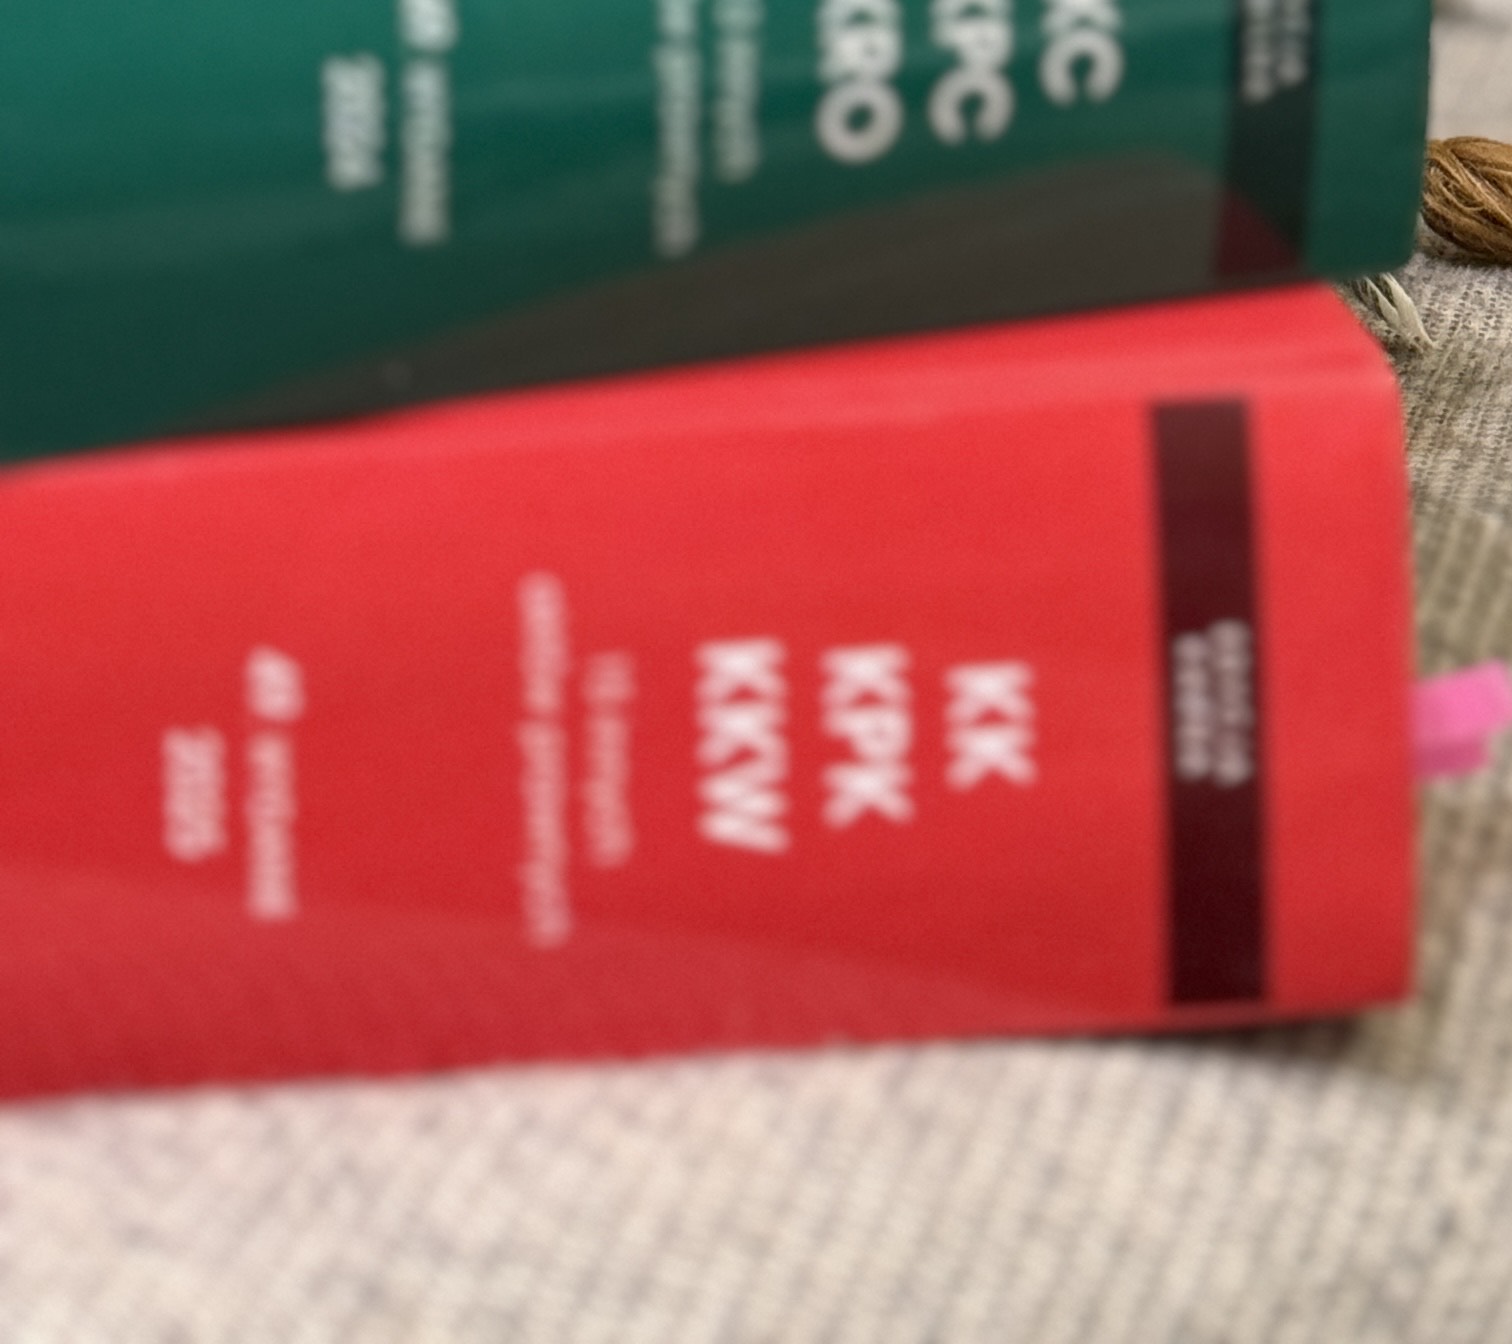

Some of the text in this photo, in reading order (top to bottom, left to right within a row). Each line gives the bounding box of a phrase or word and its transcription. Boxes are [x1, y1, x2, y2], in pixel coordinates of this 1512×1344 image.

[701, 640, 784, 850] KKW
[826, 646, 911, 822] KPK
[950, 664, 1031, 784] KK
